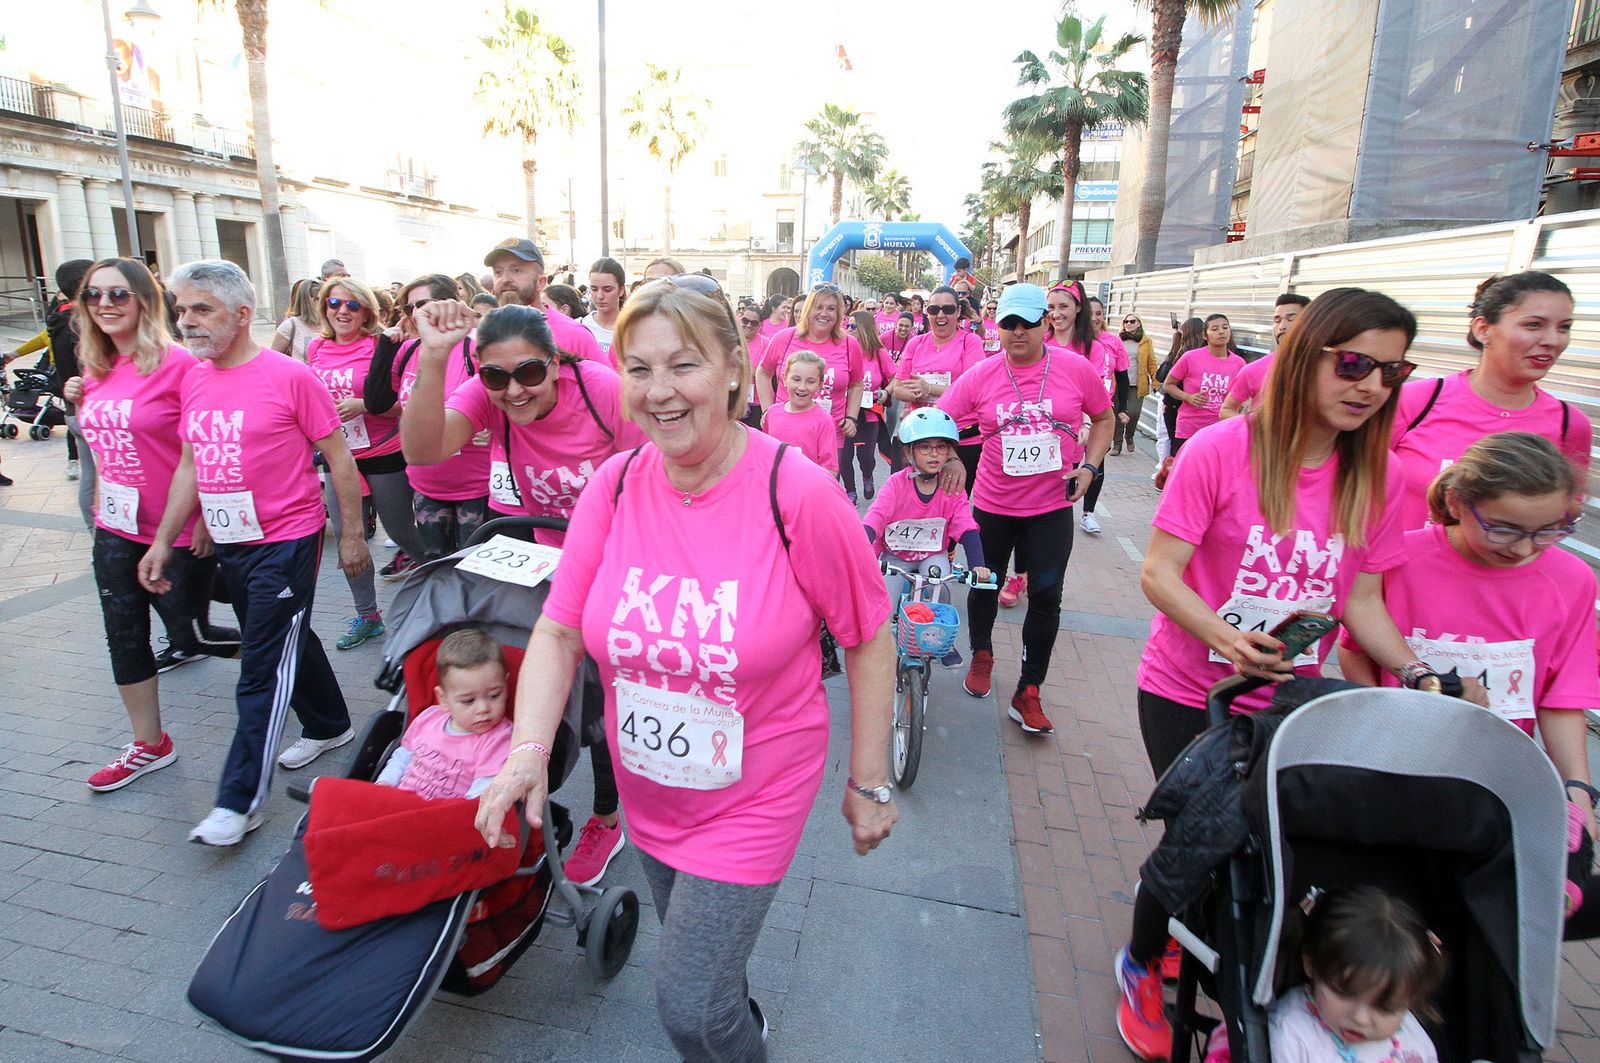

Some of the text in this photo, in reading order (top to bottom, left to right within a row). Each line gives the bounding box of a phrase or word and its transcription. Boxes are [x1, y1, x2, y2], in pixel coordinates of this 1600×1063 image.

[97, 155, 191, 177] AYUTAMIENTO
[818, 233, 844, 258] DEPORTES
[934, 235, 960, 260] DEPORTES
[1201, 372, 1230, 389] KM
[80, 399, 134, 429] KM
[187, 410, 244, 442] KM
[81, 428, 137, 452] POR
[103, 451, 141, 468] LAS
[191, 442, 243, 466] POR
[1005, 446, 1041, 463] 749
[196, 466, 244, 484] LLAS
[476, 546, 530, 568] 623
[1241, 525, 1345, 579] KM
[611, 566, 739, 643] KM
[1240, 601, 1280, 615] Carrera
[607, 627, 739, 685] POR
[632, 692, 669, 712] Carrera
[672, 702, 686, 714] de
[690, 703, 700, 715] la
[703, 706, 734, 720] Mujer
[621, 711, 690, 758] 436
